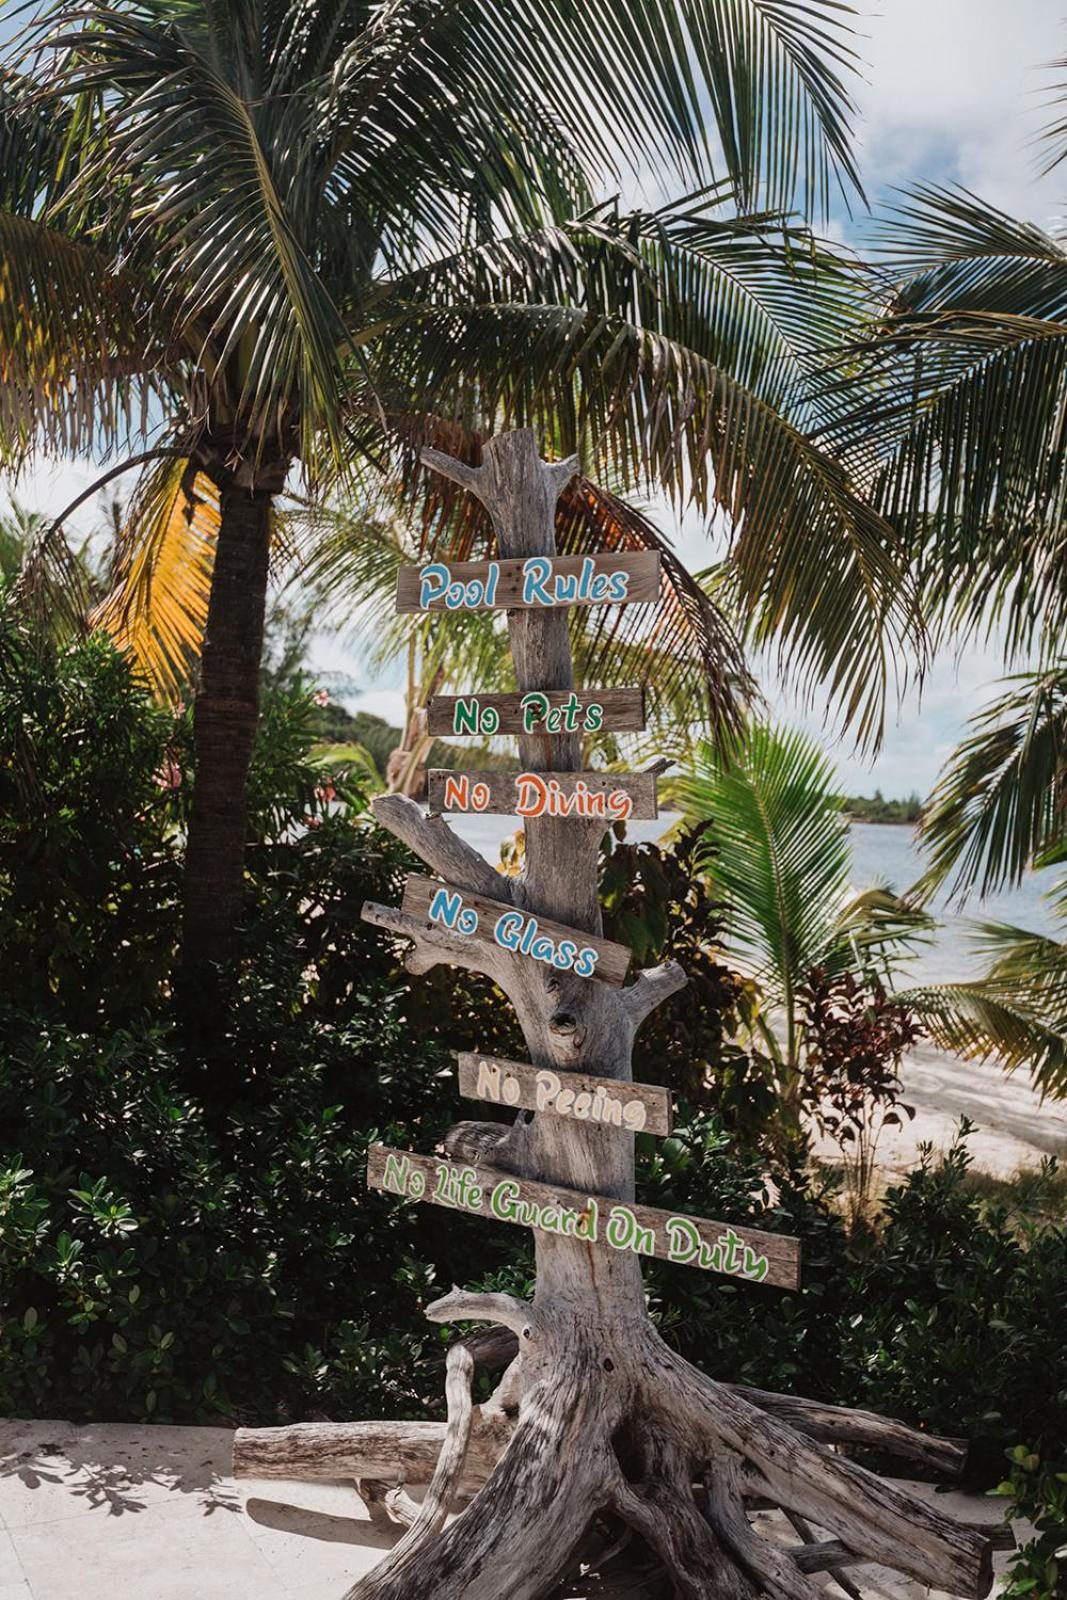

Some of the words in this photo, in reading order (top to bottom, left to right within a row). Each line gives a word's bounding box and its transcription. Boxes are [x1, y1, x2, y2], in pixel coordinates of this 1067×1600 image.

[420, 562, 499, 609] Pool
[522, 557, 630, 606] Rules
[453, 698, 499, 734] No
[521, 692, 603, 733] Pets
[444, 775, 490, 811] No
[515, 773, 632, 820] Diving
[429, 888, 478, 935] No
[494, 911, 598, 977] Glass
[477, 1061, 520, 1104] No
[535, 1070, 647, 1130] Peeing
[382, 1153, 425, 1197] No
[433, 1165, 483, 1210] Life
[490, 1180, 597, 1242] Guard
[606, 1206, 655, 1255] On
[665, 1216, 769, 1283] Duty
